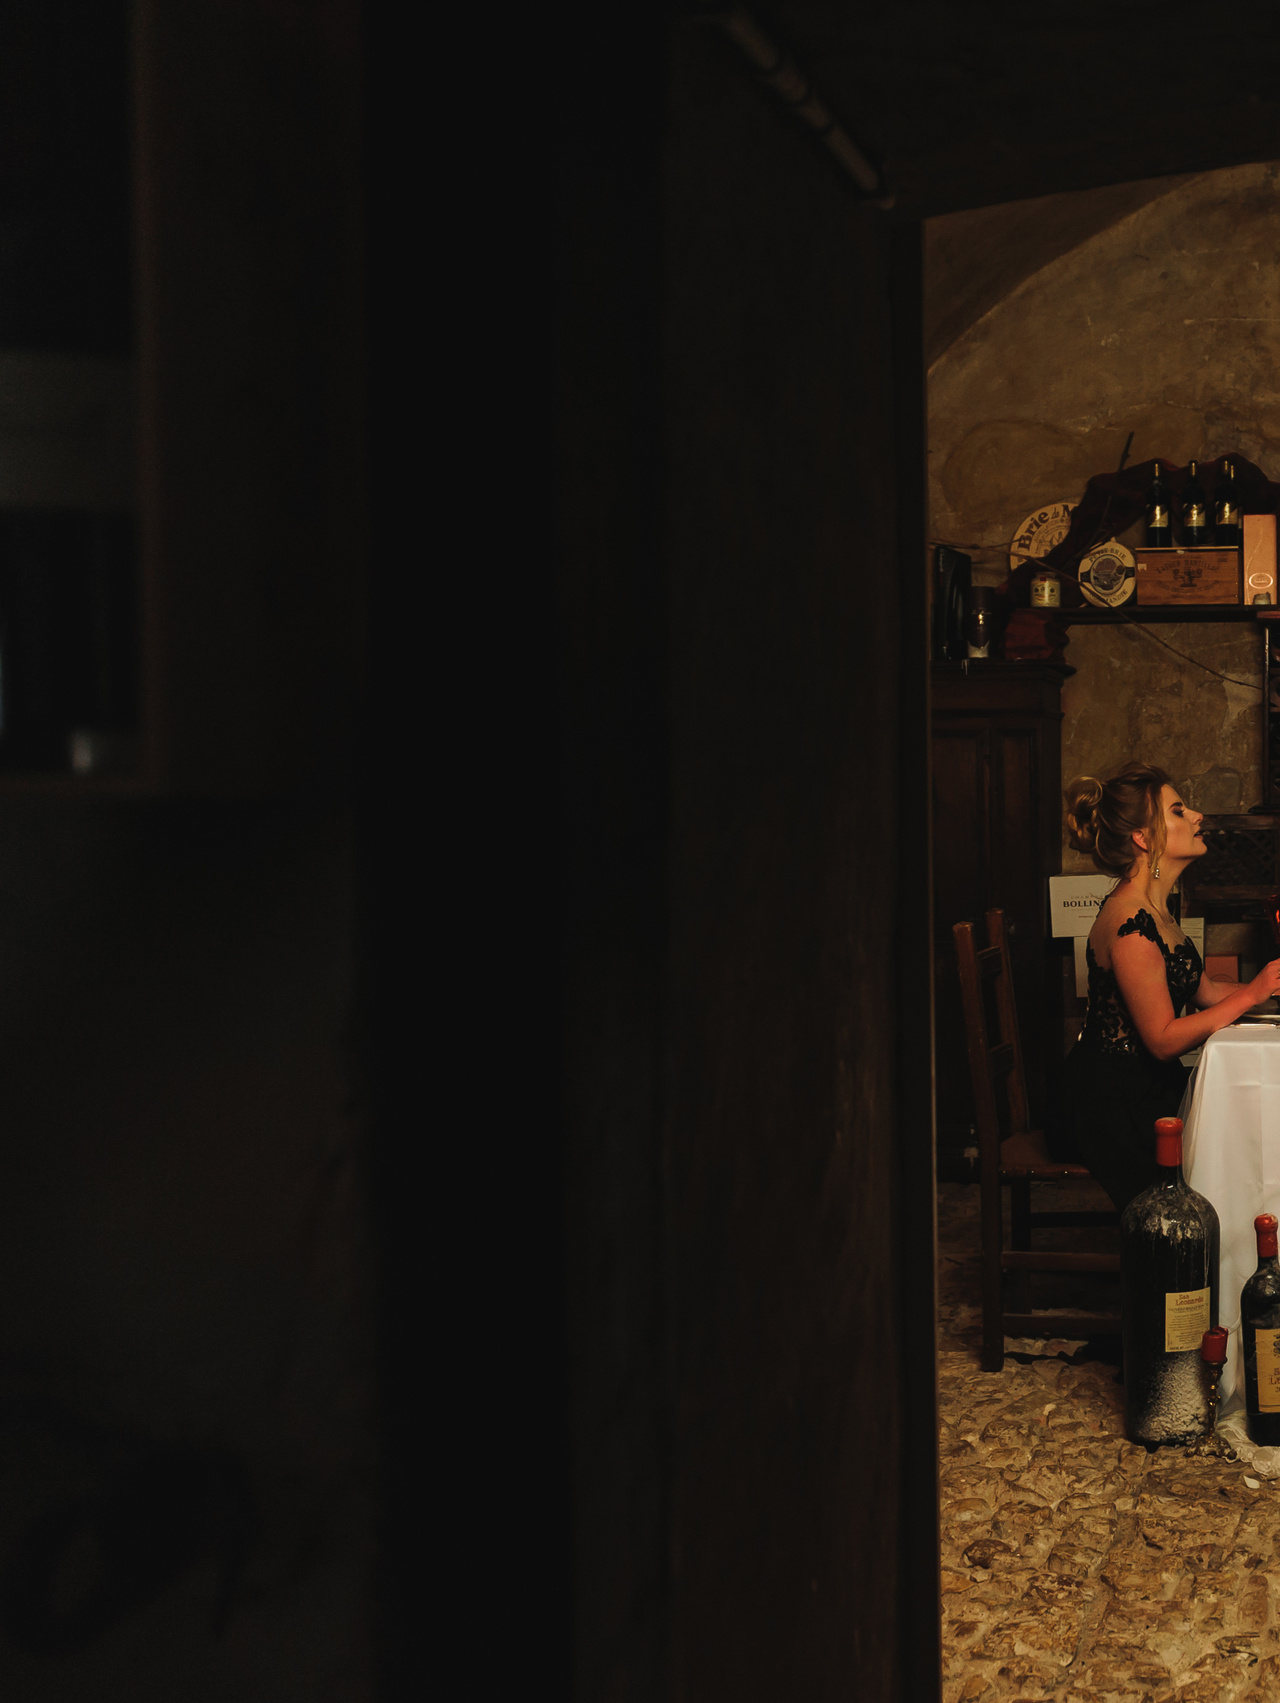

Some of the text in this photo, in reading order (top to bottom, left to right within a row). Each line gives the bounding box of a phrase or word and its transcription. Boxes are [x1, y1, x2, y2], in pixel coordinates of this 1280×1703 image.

[1017, 511, 1050, 551] Brie
[1110, 547, 1127, 560] BRIE
[1063, 900, 1100, 908] BOLLIN
